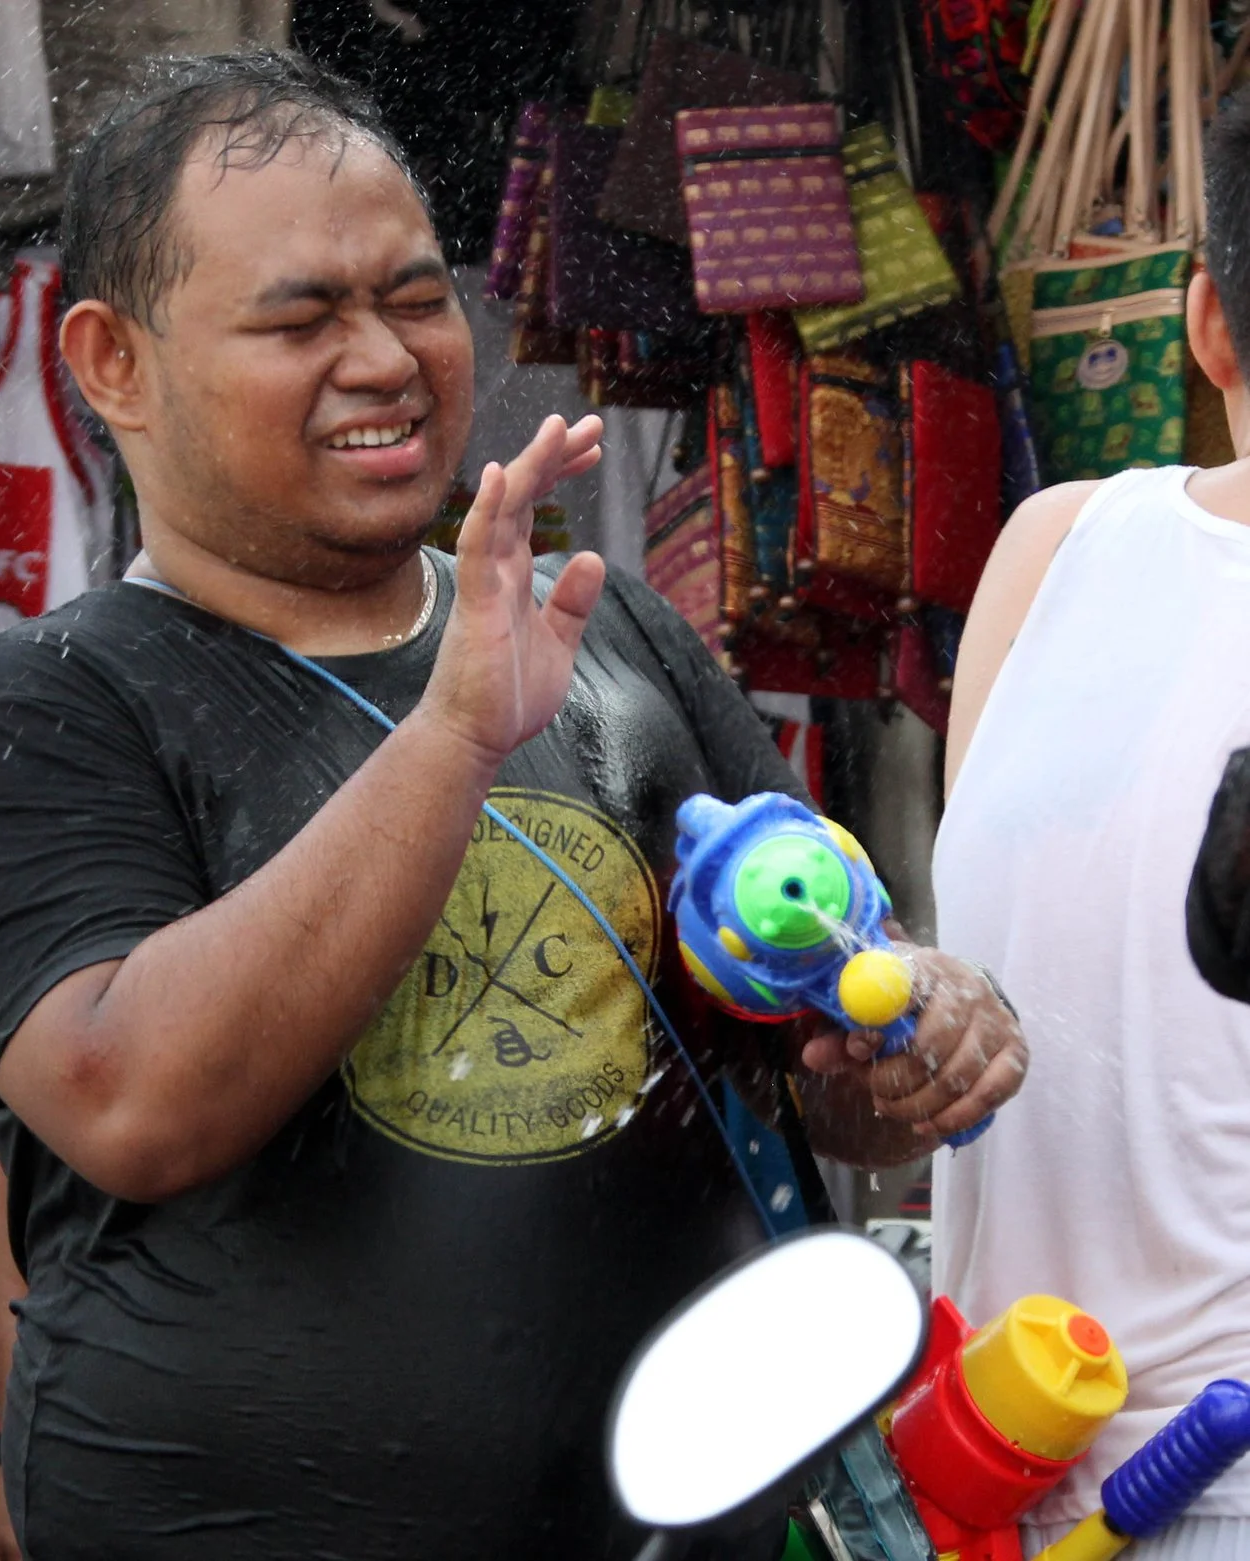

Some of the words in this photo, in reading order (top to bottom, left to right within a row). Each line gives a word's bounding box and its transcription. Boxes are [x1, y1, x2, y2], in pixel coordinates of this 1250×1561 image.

[471, 814, 606, 872] DESIGNED
[423, 951, 459, 998] D
[533, 932, 574, 979] C
[407, 1090, 535, 1136] QUALITY
[549, 1062, 625, 1129] GOODS
